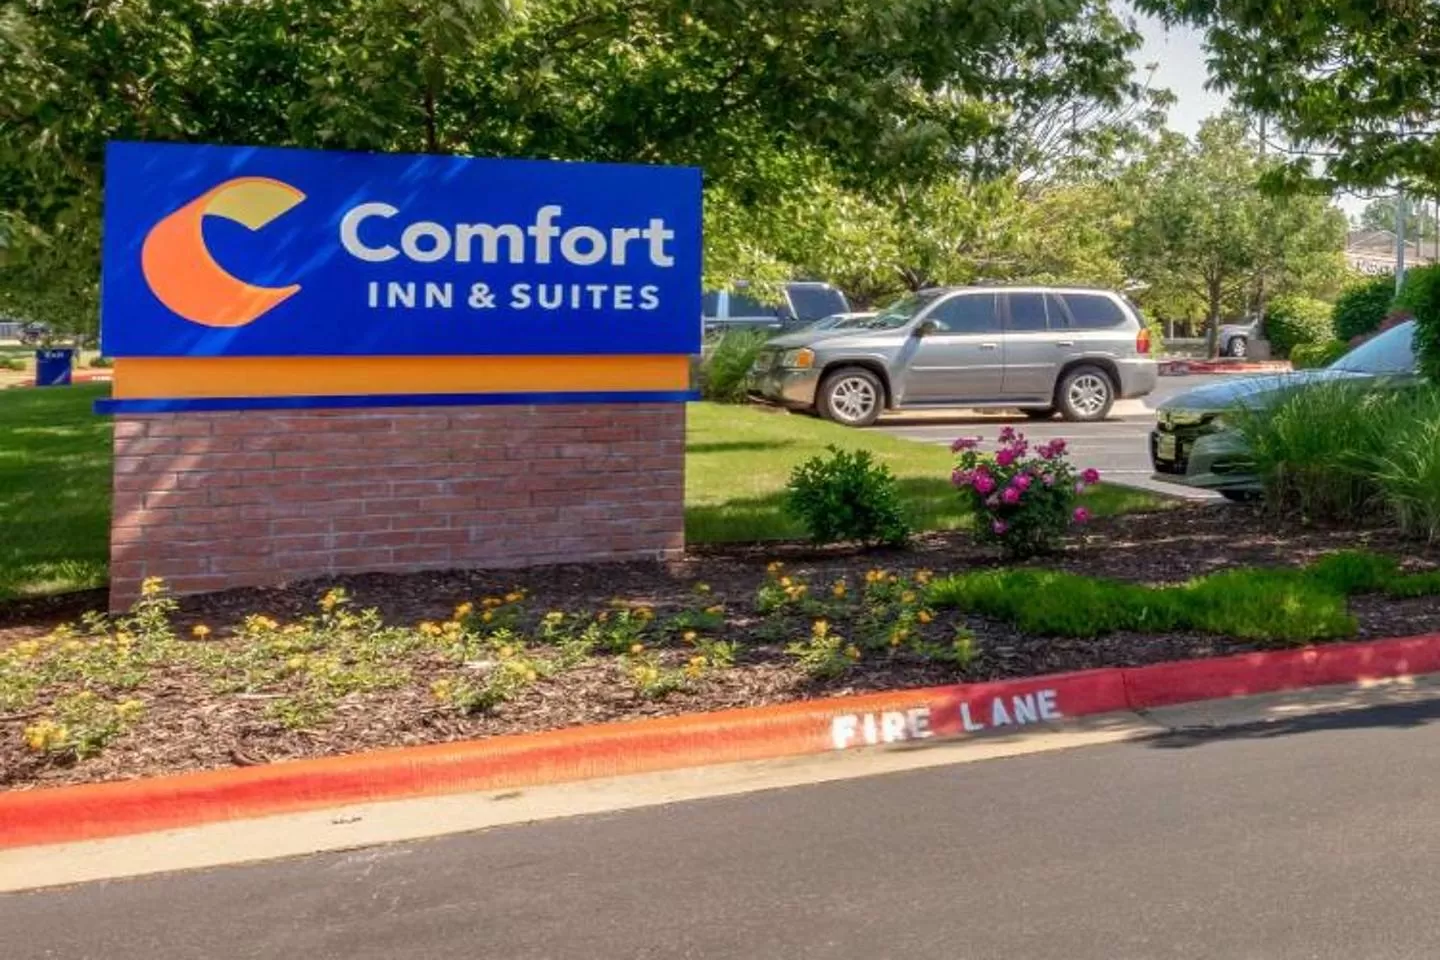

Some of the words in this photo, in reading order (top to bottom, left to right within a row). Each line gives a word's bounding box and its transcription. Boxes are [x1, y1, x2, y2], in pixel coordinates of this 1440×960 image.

[340, 202, 674, 267] Comfort
[368, 282, 452, 308] INN
[468, 283, 495, 308] &
[511, 283, 660, 310] SUITES
[830, 708, 933, 749] FIRE
[959, 689, 1061, 732] LANE
